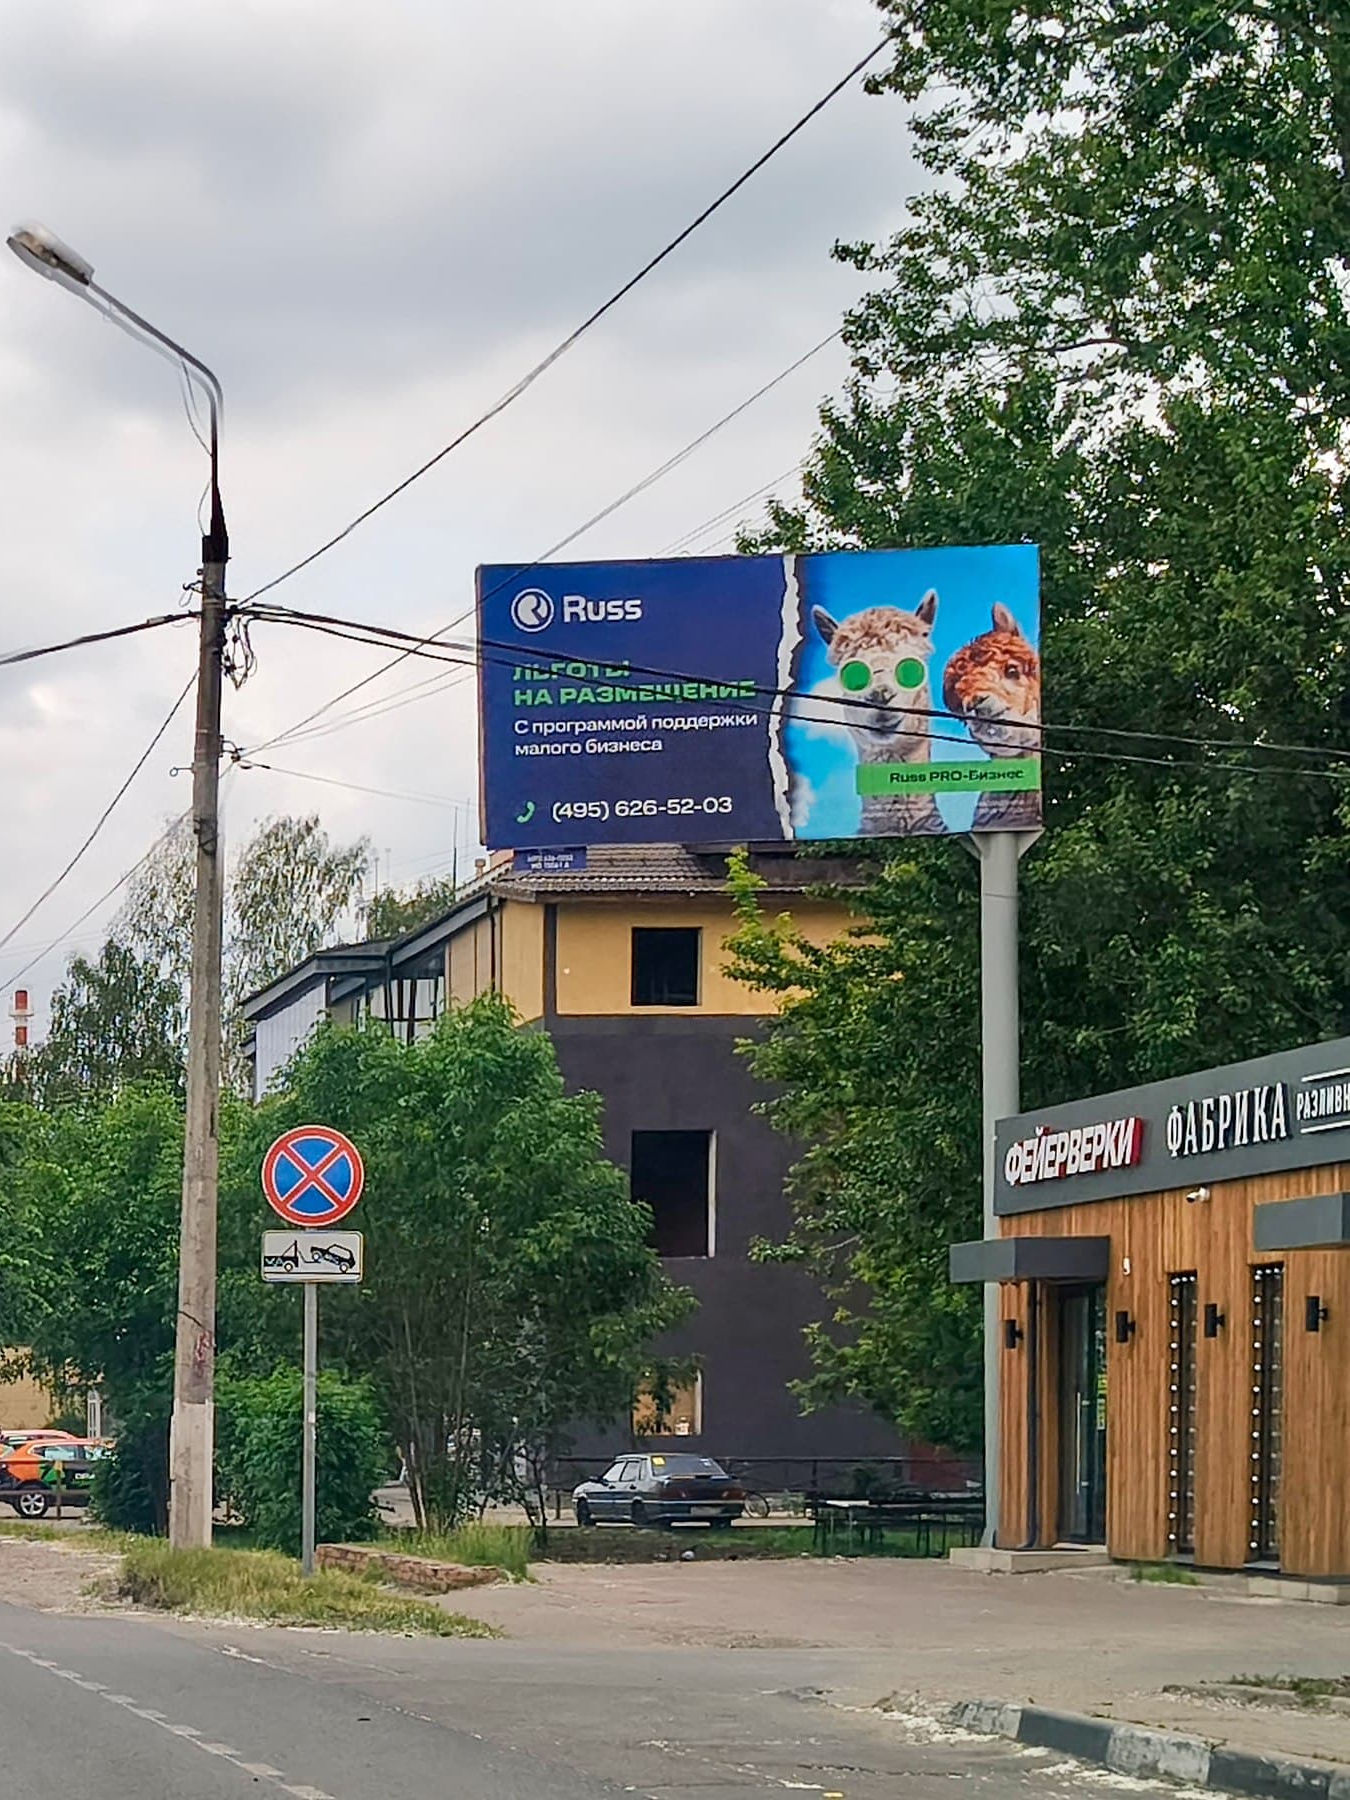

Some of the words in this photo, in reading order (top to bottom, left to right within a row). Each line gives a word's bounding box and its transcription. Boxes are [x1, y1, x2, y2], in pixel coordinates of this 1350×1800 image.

[563, 595, 642, 622] Russ
[514, 688, 553, 706] НА
[560, 680, 756, 705] РАЗМЕЩЕНИЕ
[514, 720, 529, 734] С
[532, 714, 648, 736] программой
[652, 714, 758, 730] поддержки
[515, 743, 582, 756] малого
[585, 738, 663, 754] бизнеса
[890, 772, 926, 783] Russ
[929, 770, 1024, 782] PRO-Бизнес
[552, 801, 610, 823] (495)
[614, 797, 732, 817] 626-52-03
[1166, 1082, 1288, 1158] ФАБРИКА
[1004, 1117, 1139, 1186] ФЕЙЕРВЕРКИ
